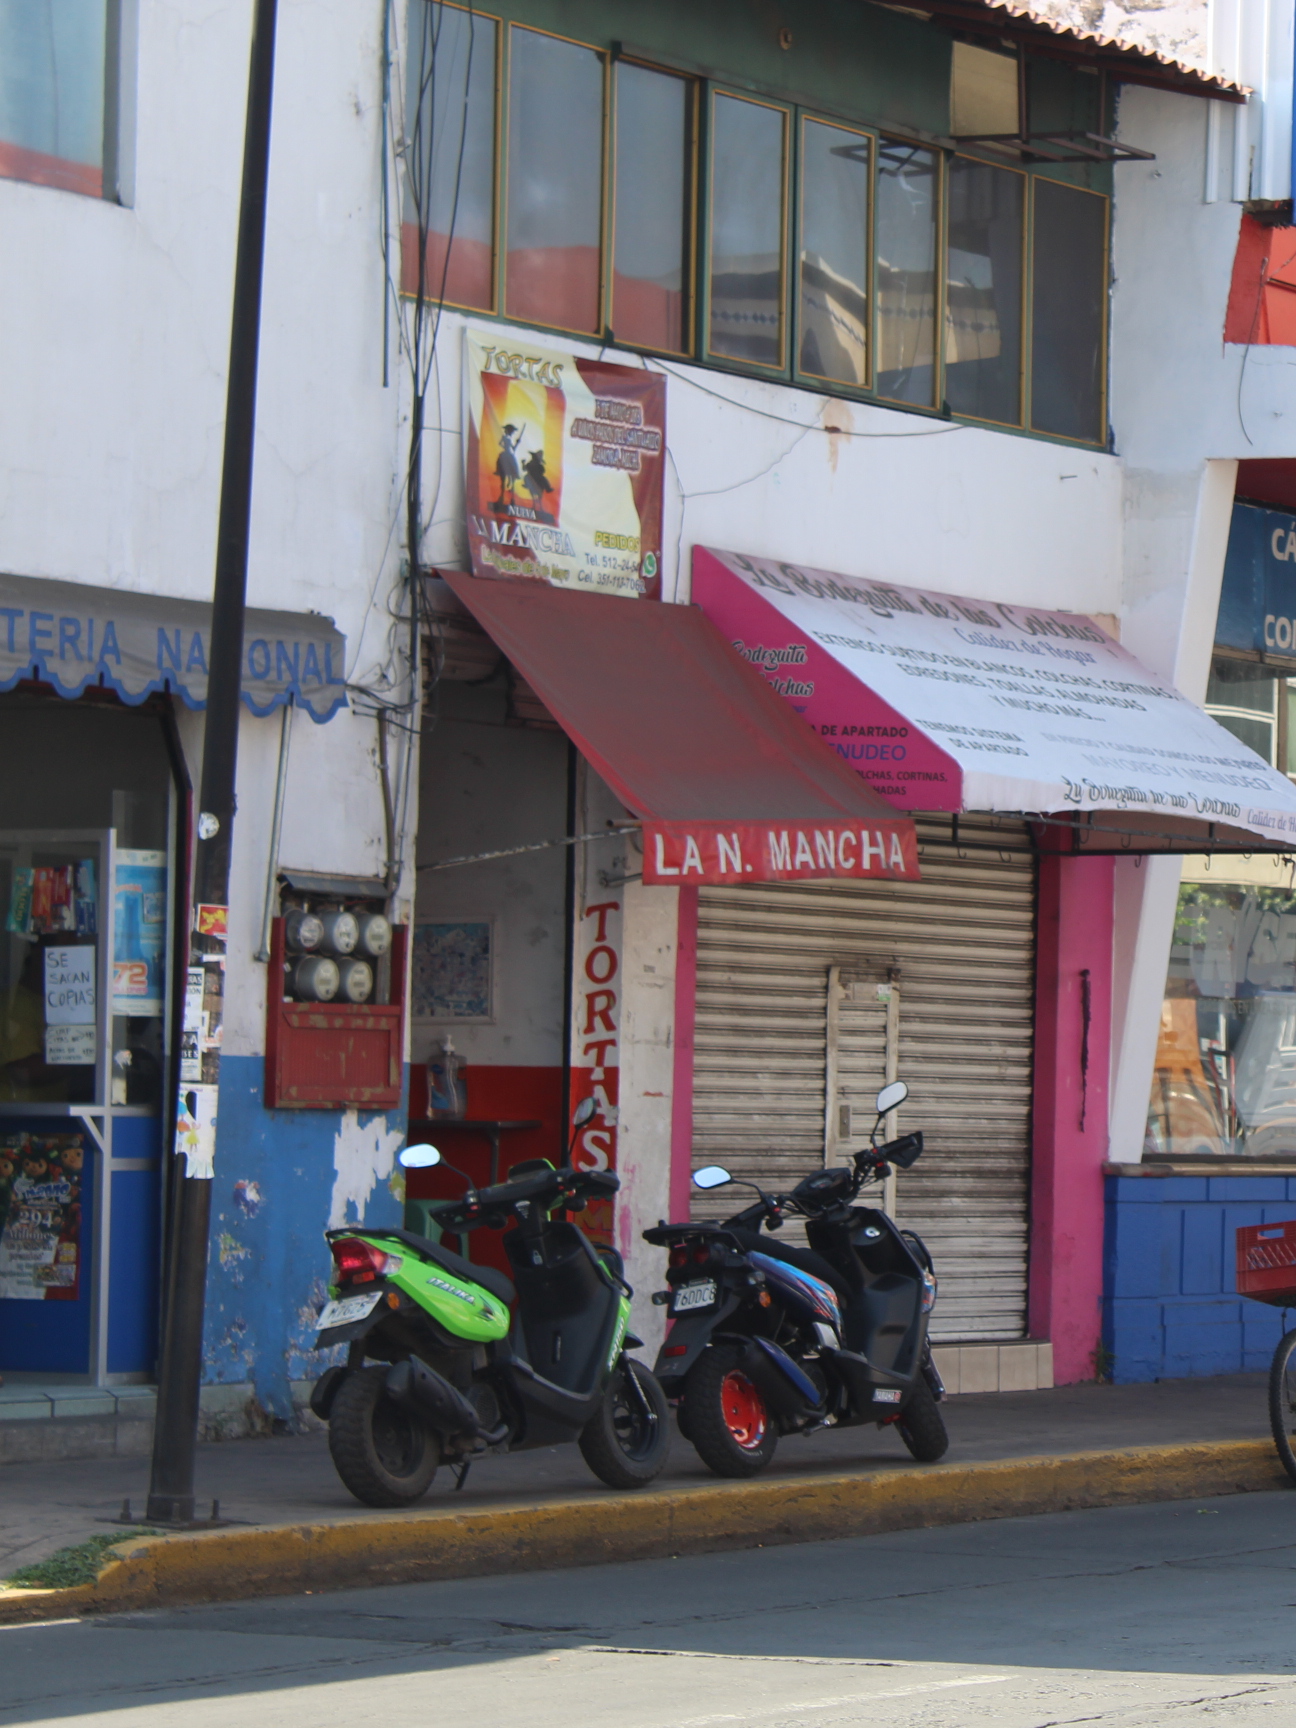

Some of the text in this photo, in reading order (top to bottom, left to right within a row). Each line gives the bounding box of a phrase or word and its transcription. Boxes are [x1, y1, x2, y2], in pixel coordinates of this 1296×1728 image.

[481, 346, 564, 389] TORTAS
[508, 504, 536, 519] NUEVA
[491, 520, 576, 557] MANCHA
[595, 530, 640, 553] PEDIDOS
[584, 552, 599, 568] Tel.
[577, 570, 594, 584] Cel.
[779, 560, 923, 619] Bodeguita
[994, 602, 1106, 644] Colchas
[157, 627, 346, 685] NAONAL
[813, 631, 885, 655] EXTENSO
[887, 643, 948, 666] SURTIDO
[953, 627, 1097, 666] Calidez de Hogar
[1001, 696, 1060, 715] MUCHO
[1055, 688, 1148, 712] ALMOHADAS
[821, 724, 838, 737] DE
[841, 726, 908, 738] APARTADO
[915, 719, 976, 737] TENEMOS
[948, 738, 1029, 757] DE APARTADO
[1082, 753, 1172, 777] MAYOREO
[1183, 766, 1274, 792] MENUDEO
[1247, 808, 1277, 830] Calidez
[1277, 815, 1288, 832] de
[655, 829, 906, 876] LA N. MANCHA
[47, 951, 69, 969] SE
[49, 971, 90, 985] SACAN
[113, 961, 149, 987] 72
[47, 988, 95, 1008] COPIAS
[578, 901, 620, 1172] TORTAS
[19, 1210, 54, 1228] 294
[426, 1276, 476, 1305] ITALIKA
